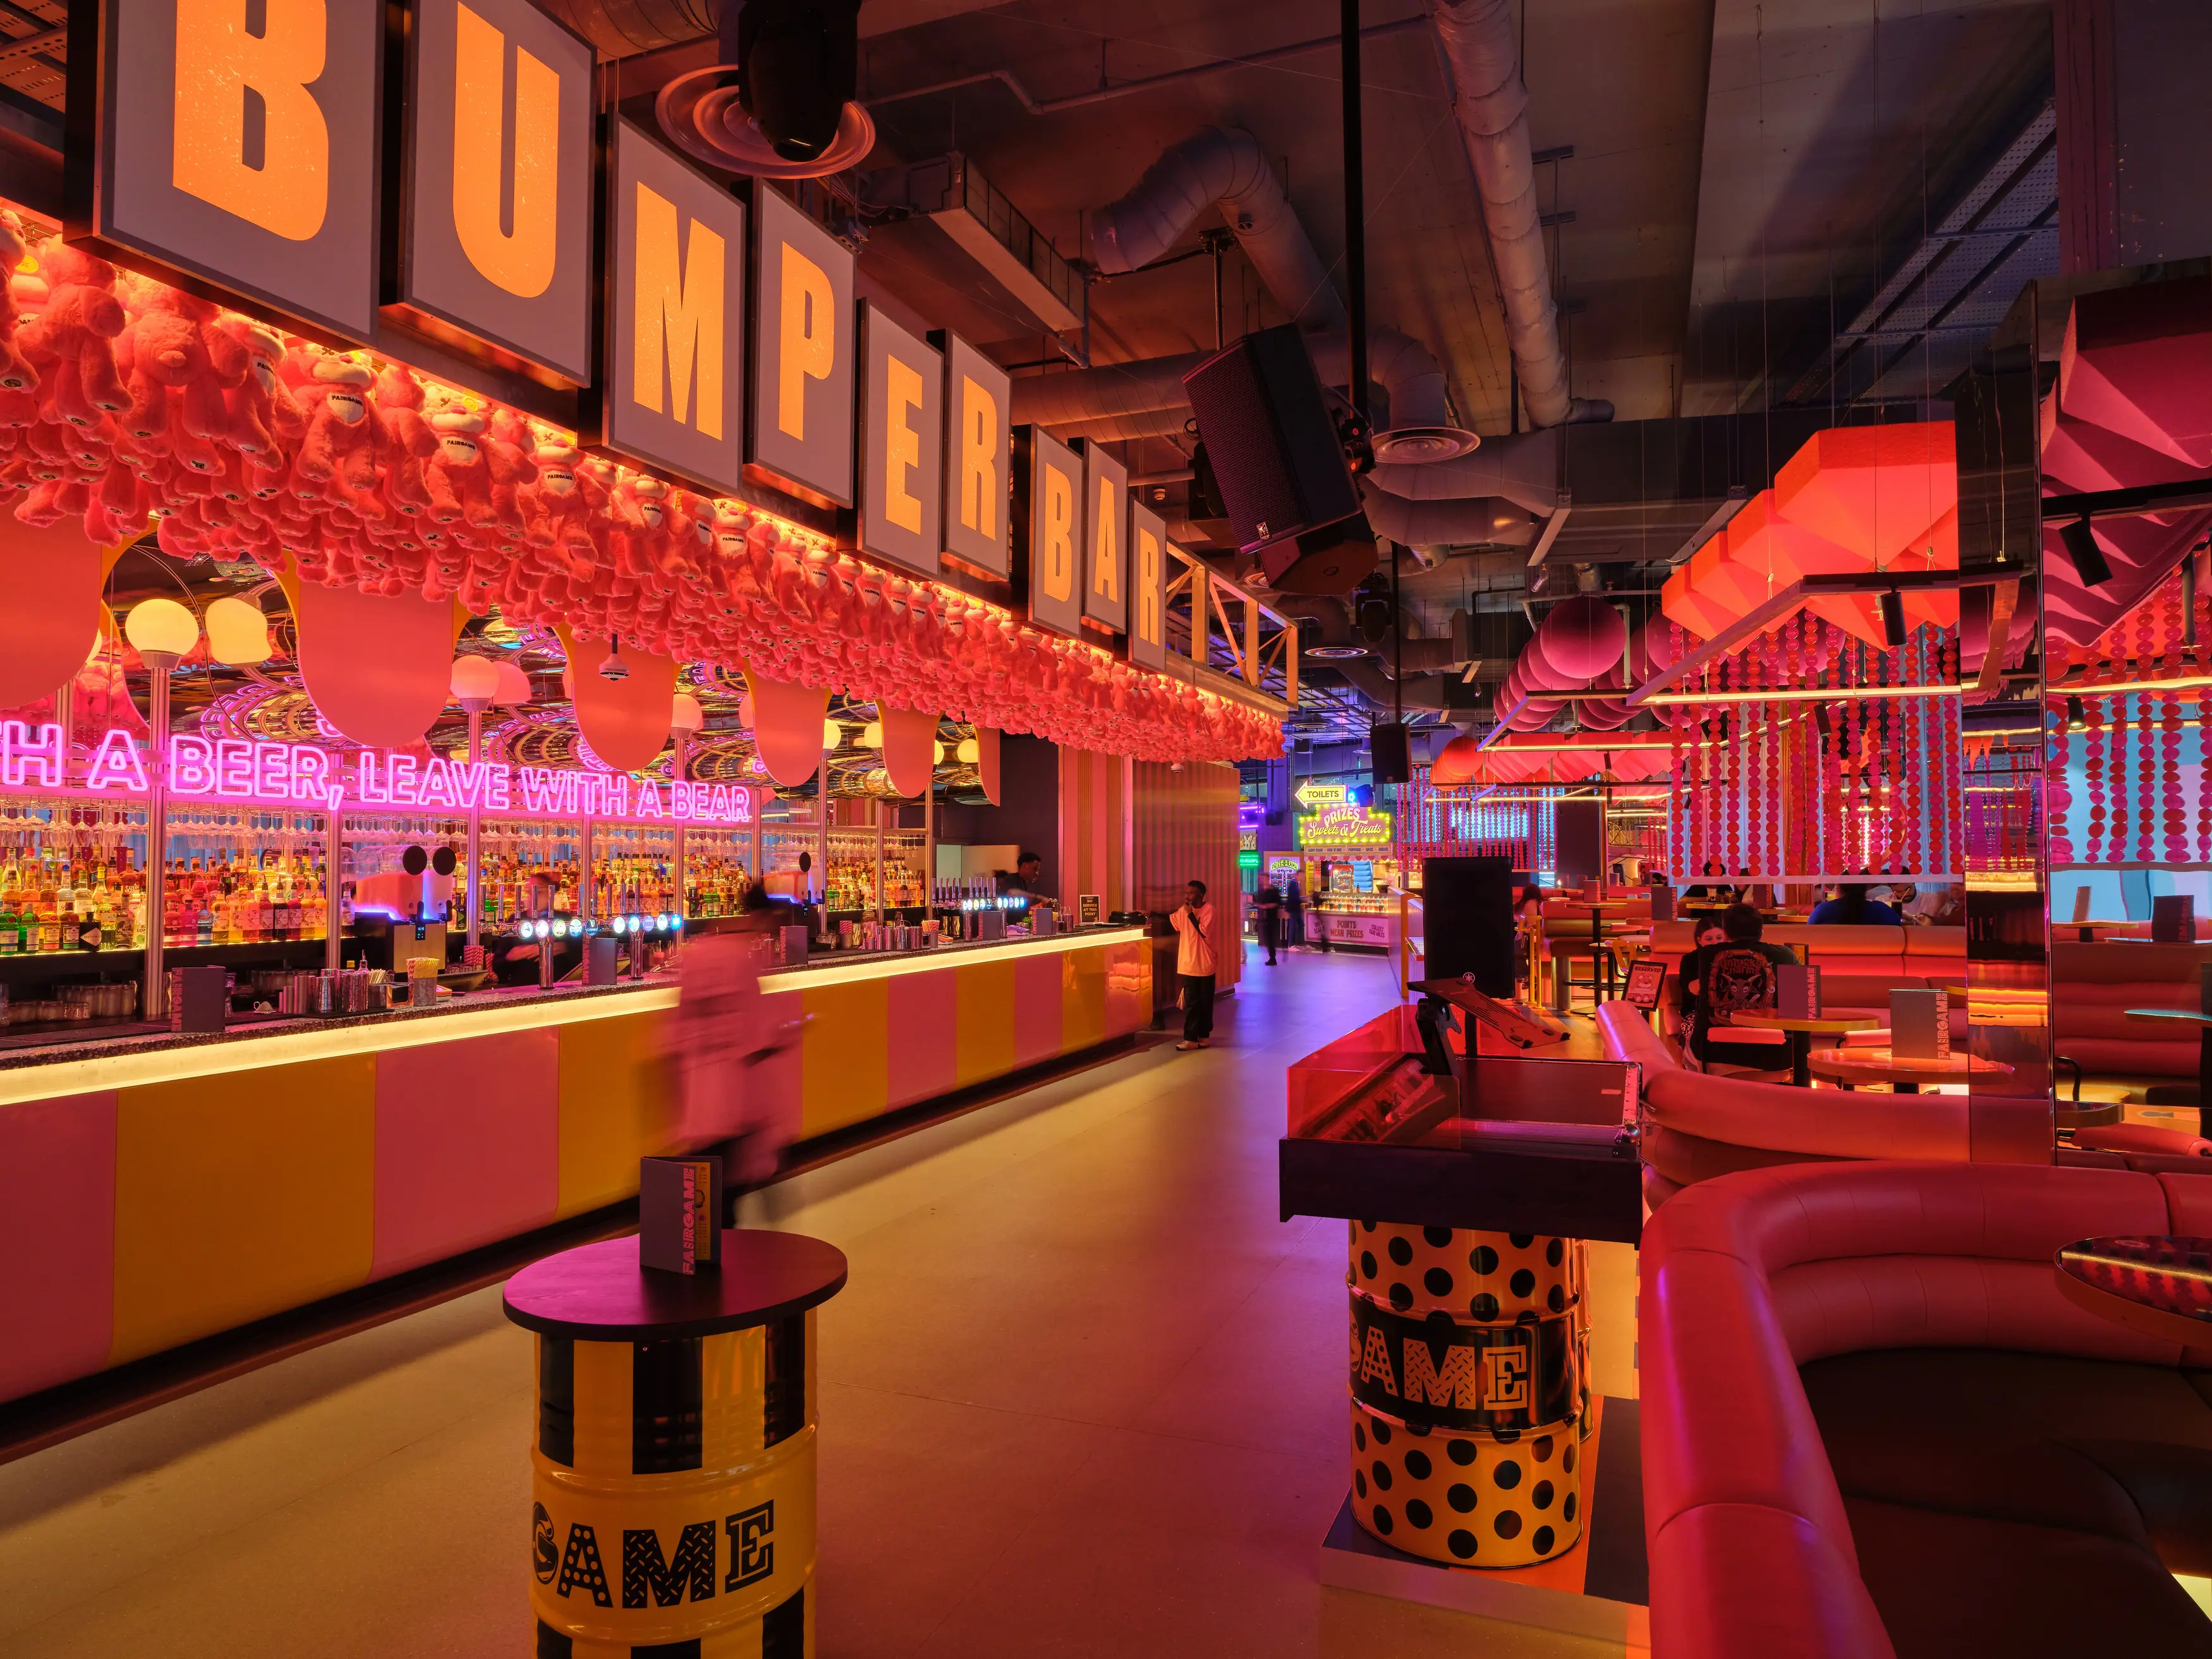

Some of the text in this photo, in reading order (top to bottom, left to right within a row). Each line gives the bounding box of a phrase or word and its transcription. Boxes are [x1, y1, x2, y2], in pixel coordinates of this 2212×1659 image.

[173, 0, 1160, 645] BUMPER BAR
[447, 440, 476, 450] FAIRGAME
[0, 720, 63, 787] H
[86, 729, 149, 792] A
[169, 734, 344, 811] BEER,
[360, 751, 509, 810] LEAVE
[520, 766, 628, 817] WITH
[636, 778, 663, 818] A
[671, 780, 750, 822] BEAR
[1307, 822, 1340, 839] Sweets
[1349, 820, 1383, 838] Treats
[1323, 807, 1361, 827] PRIZES
[1272, 860, 1297, 871] PRIZE-O-RAMA
[1330, 928, 1363, 939] MEAN PRIZES
[1337, 920, 1356, 928] POINTS
[171, 968, 183, 1031] FAIRGAME
[1807, 968, 1817, 1019] FAIRGAME
[1936, 993, 1950, 1059] FAIRGAME
[683, 1168, 695, 1275] FAIRGAME
